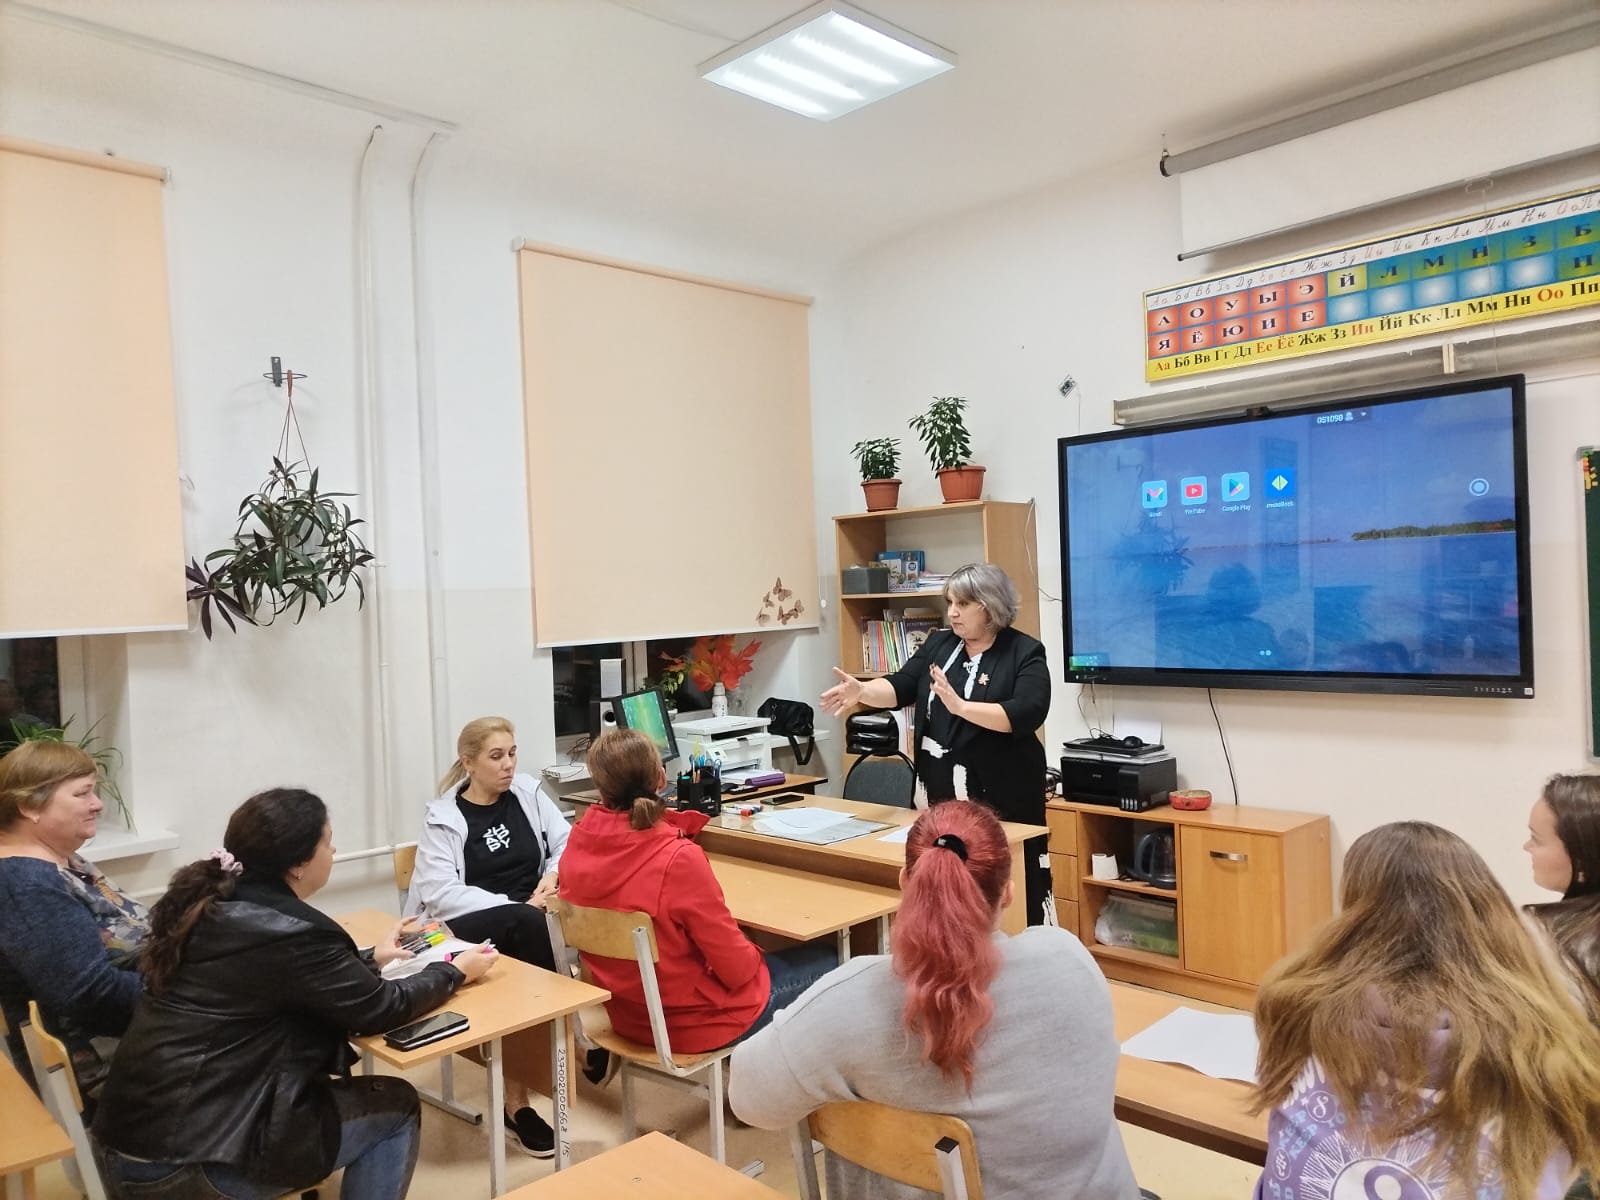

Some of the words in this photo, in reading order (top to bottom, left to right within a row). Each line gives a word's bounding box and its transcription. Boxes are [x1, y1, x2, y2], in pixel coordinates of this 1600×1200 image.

[1157, 316, 1171, 327] А
[1190, 307, 1204, 319] О
[1225, 299, 1240, 312] У
[1259, 291, 1277, 304] Ы
[1299, 284, 1314, 295] Э
[1340, 273, 1355, 288] Й
[1380, 264, 1398, 279] Л
[1423, 256, 1445, 270] М
[1471, 245, 1489, 259] Н
[1523, 235, 1537, 248] З
[1575, 224, 1592, 237] Б
[1158, 338, 1170, 351] Я
[1192, 331, 1203, 344] Ё
[1222, 326, 1244, 338] Ю
[1262, 318, 1276, 330] И
[1301, 310, 1314, 322] Е
[1573, 254, 1593, 269] П
[1155, 362, 1171, 372] Аа
[1174, 356, 1190, 368] Бб
[1194, 353, 1211, 365] Вв
[1214, 350, 1231, 361] Гг
[1234, 346, 1251, 359] Дд
[1256, 342, 1273, 354] Ее
[1277, 335, 1295, 350] Ёё
[1298, 332, 1326, 346] Жж
[1330, 328, 1347, 339] Зз
[1351, 323, 1373, 336] Ии
[1380, 316, 1402, 331] Йй
[1409, 313, 1432, 325] Кк
[1436, 307, 1461, 320] Лл
[1467, 300, 1498, 315] Мм
[1505, 294, 1530, 308] Нн
[1537, 288, 1563, 302] Оо
[1570, 282, 1599, 297] Пп
